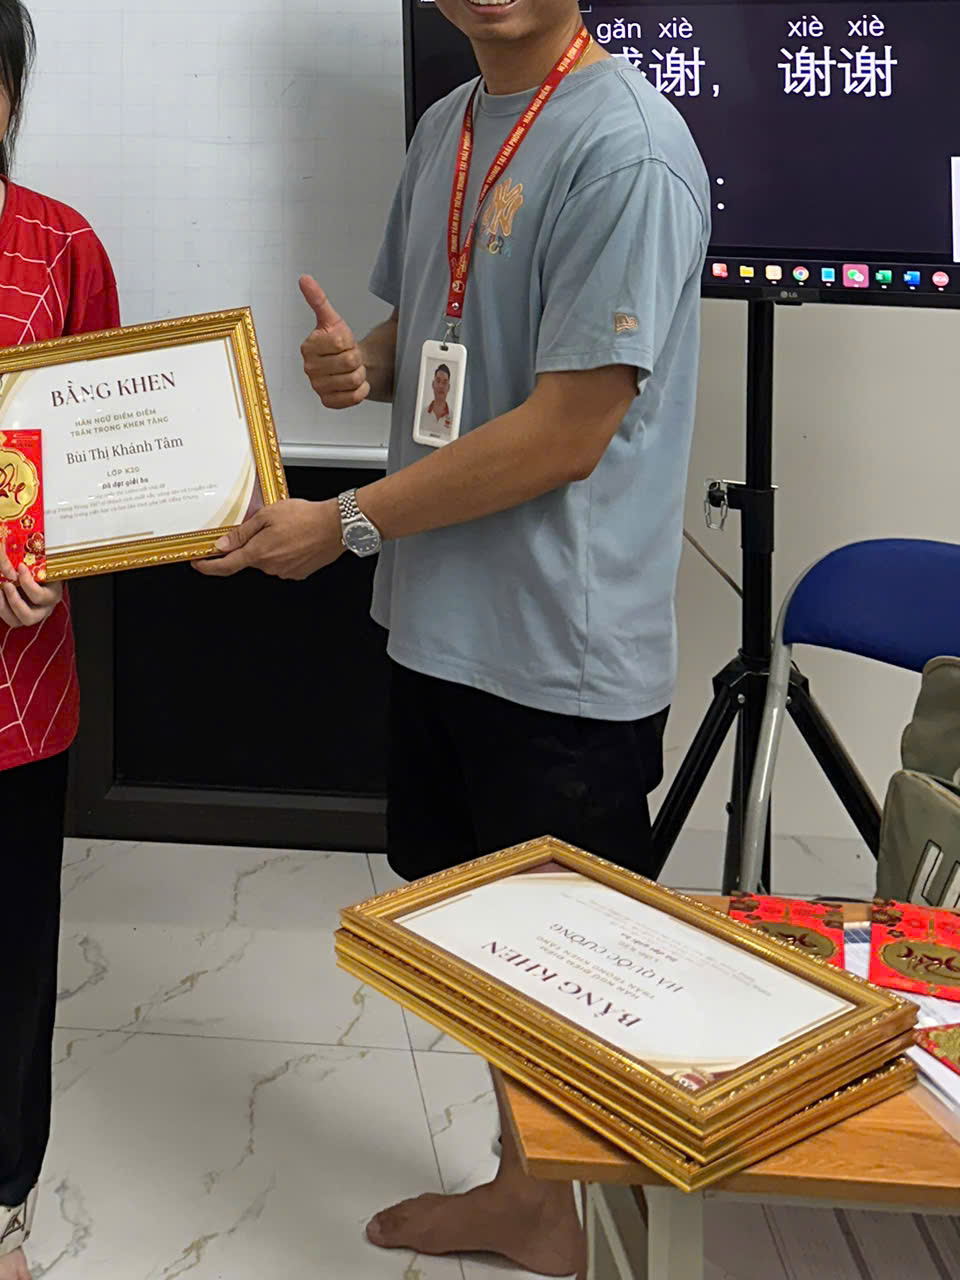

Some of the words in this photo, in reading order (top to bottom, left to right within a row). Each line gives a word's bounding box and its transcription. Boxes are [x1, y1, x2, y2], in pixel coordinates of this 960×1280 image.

[596, 18, 642, 43] gǎn
[658, 16, 693, 39] xiè
[788, 15, 824, 37] xiè
[847, 14, 885, 37] xiè
[486, 165, 501, 184] TRUNG
[508, 126, 525, 147] PHÒNG
[456, 170, 466, 190] TRUNG
[51, 380, 111, 407] BẰNG
[117, 371, 176, 396] KHEN
[70, 427, 92, 438] TRÂN
[123, 420, 145, 430] KHEN
[94, 414, 112, 424] NGỮ
[66, 451, 87, 464] Bùi
[88, 446, 110, 461] Thị
[111, 440, 153, 457] Khánh
[154, 436, 184, 451] Tâm
[107, 468, 123, 477] LỚP
[481, 941, 558, 983] KHEN
